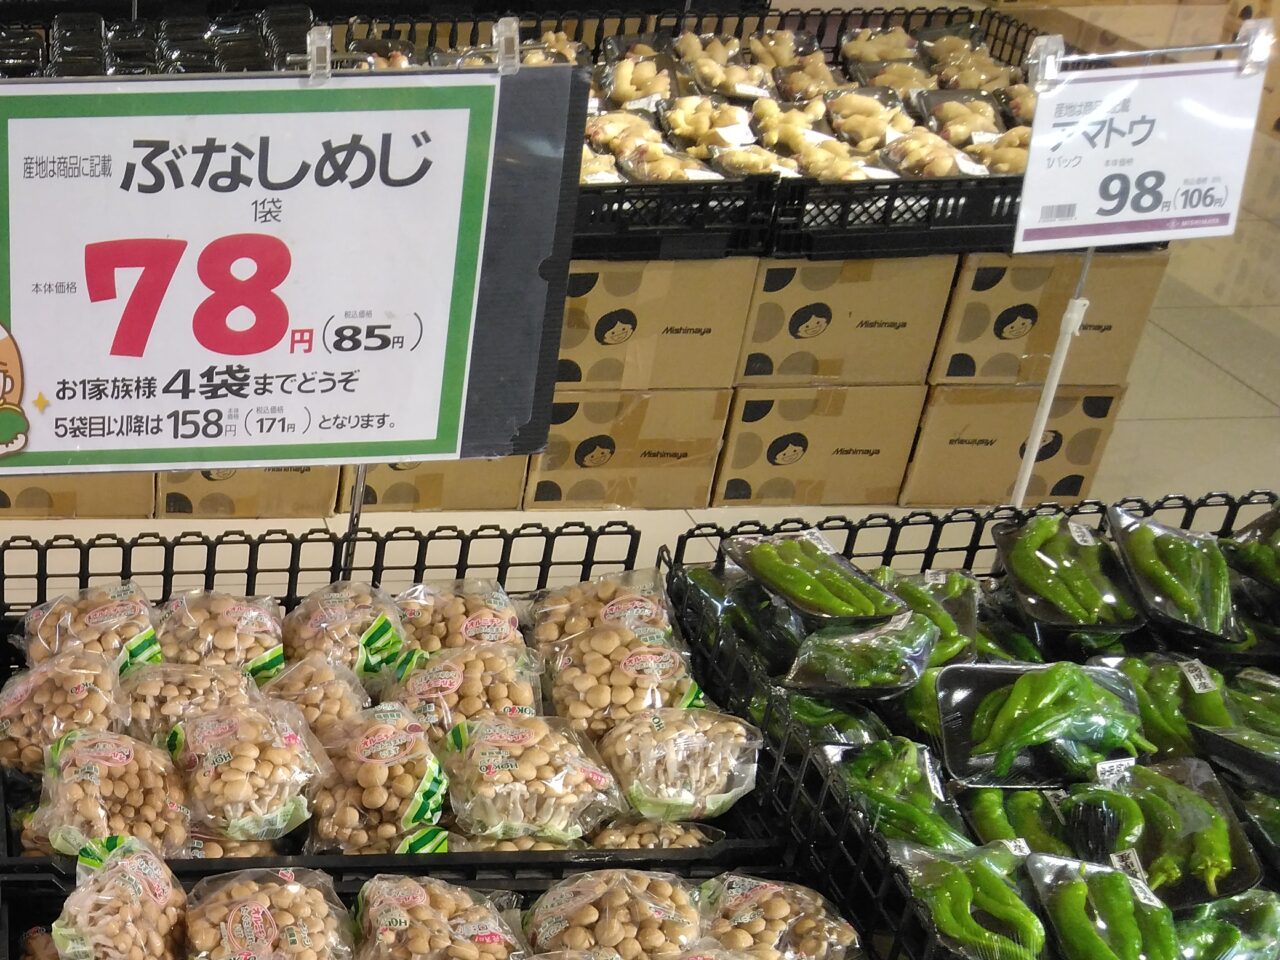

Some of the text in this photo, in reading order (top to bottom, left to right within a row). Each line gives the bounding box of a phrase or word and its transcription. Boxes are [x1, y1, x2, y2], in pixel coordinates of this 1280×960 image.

[120, 131, 433, 194] ぶなしめじ
[251, 198, 282, 223] 1袋
[31, 281, 77, 294] 本体価格
[856, 318, 908, 330] Mishimaya
[662, 325, 712, 337] Mishimaya
[640, 449, 688, 460] Mishimaya
[832, 446, 880, 457] Mishimaya
